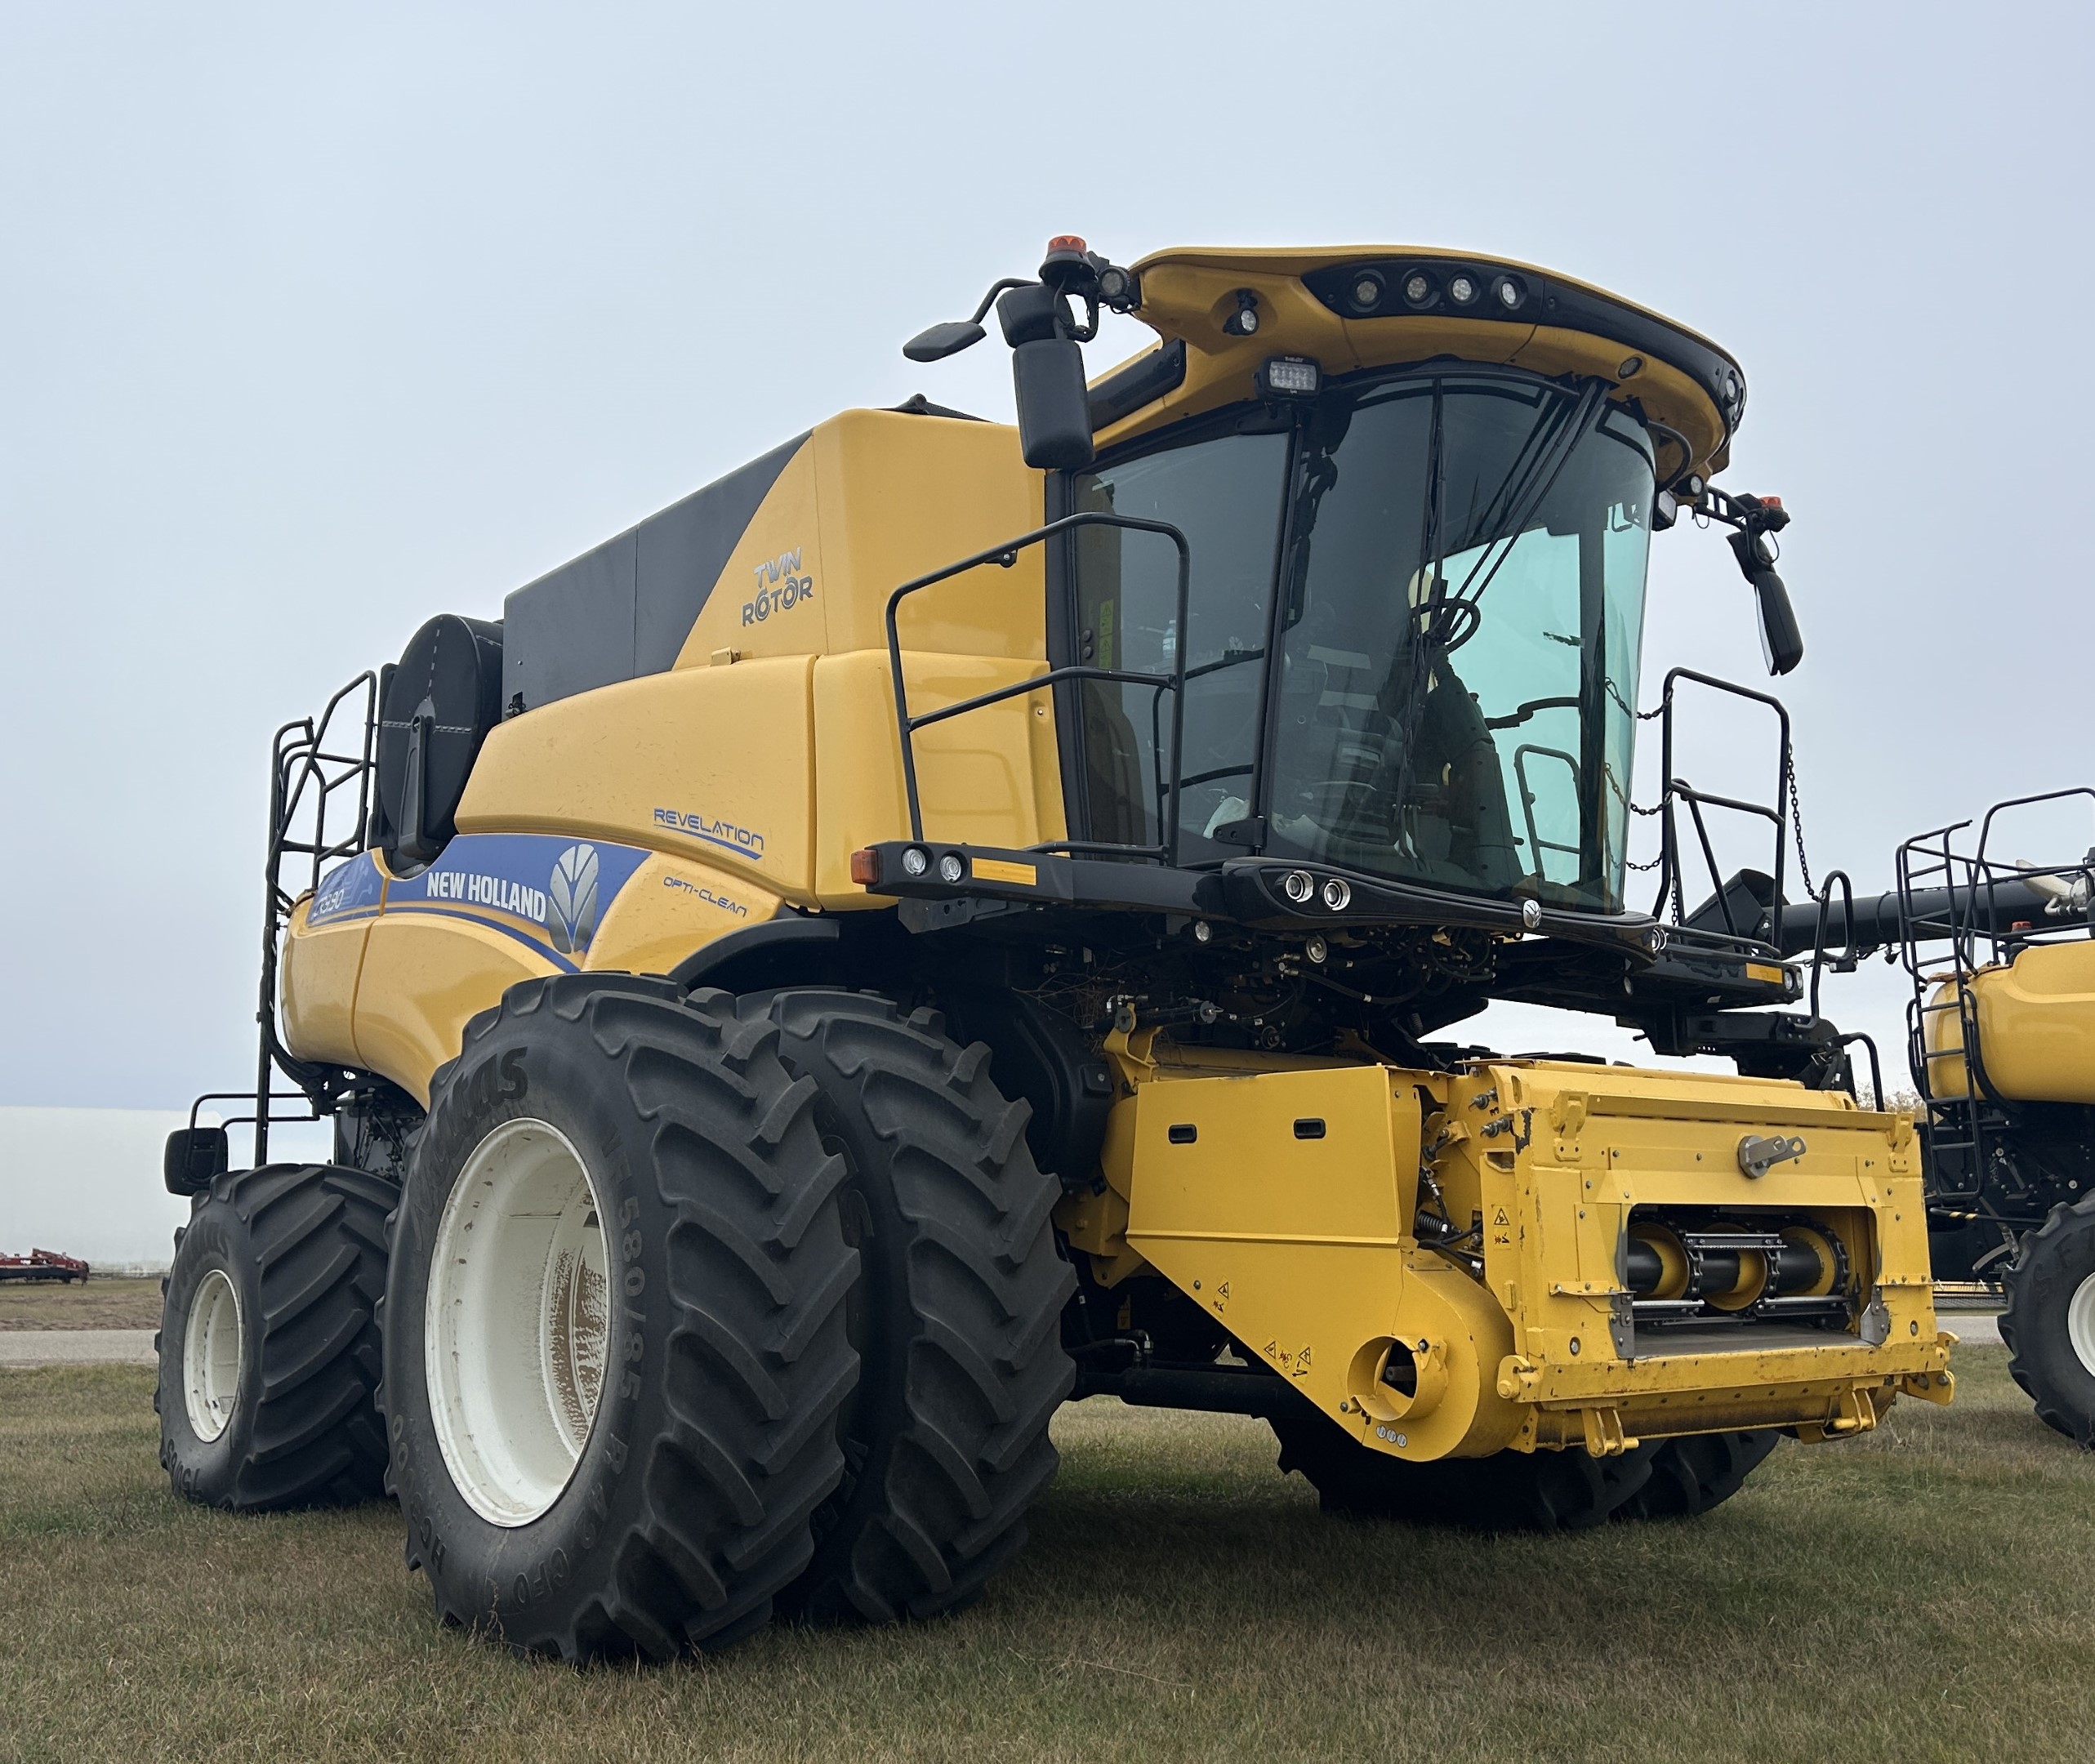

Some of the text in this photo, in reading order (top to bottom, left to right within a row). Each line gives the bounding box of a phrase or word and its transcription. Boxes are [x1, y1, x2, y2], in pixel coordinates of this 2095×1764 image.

[754, 547, 801, 588] TWIN
[742, 576, 813, 626] ROTOR
[654, 808, 764, 850] REVELATION
[427, 871, 546, 923] NEW HOLLAND
[663, 876, 747, 917] OPTI-CLEAN
[619, 1195, 646, 1401] 580/85
